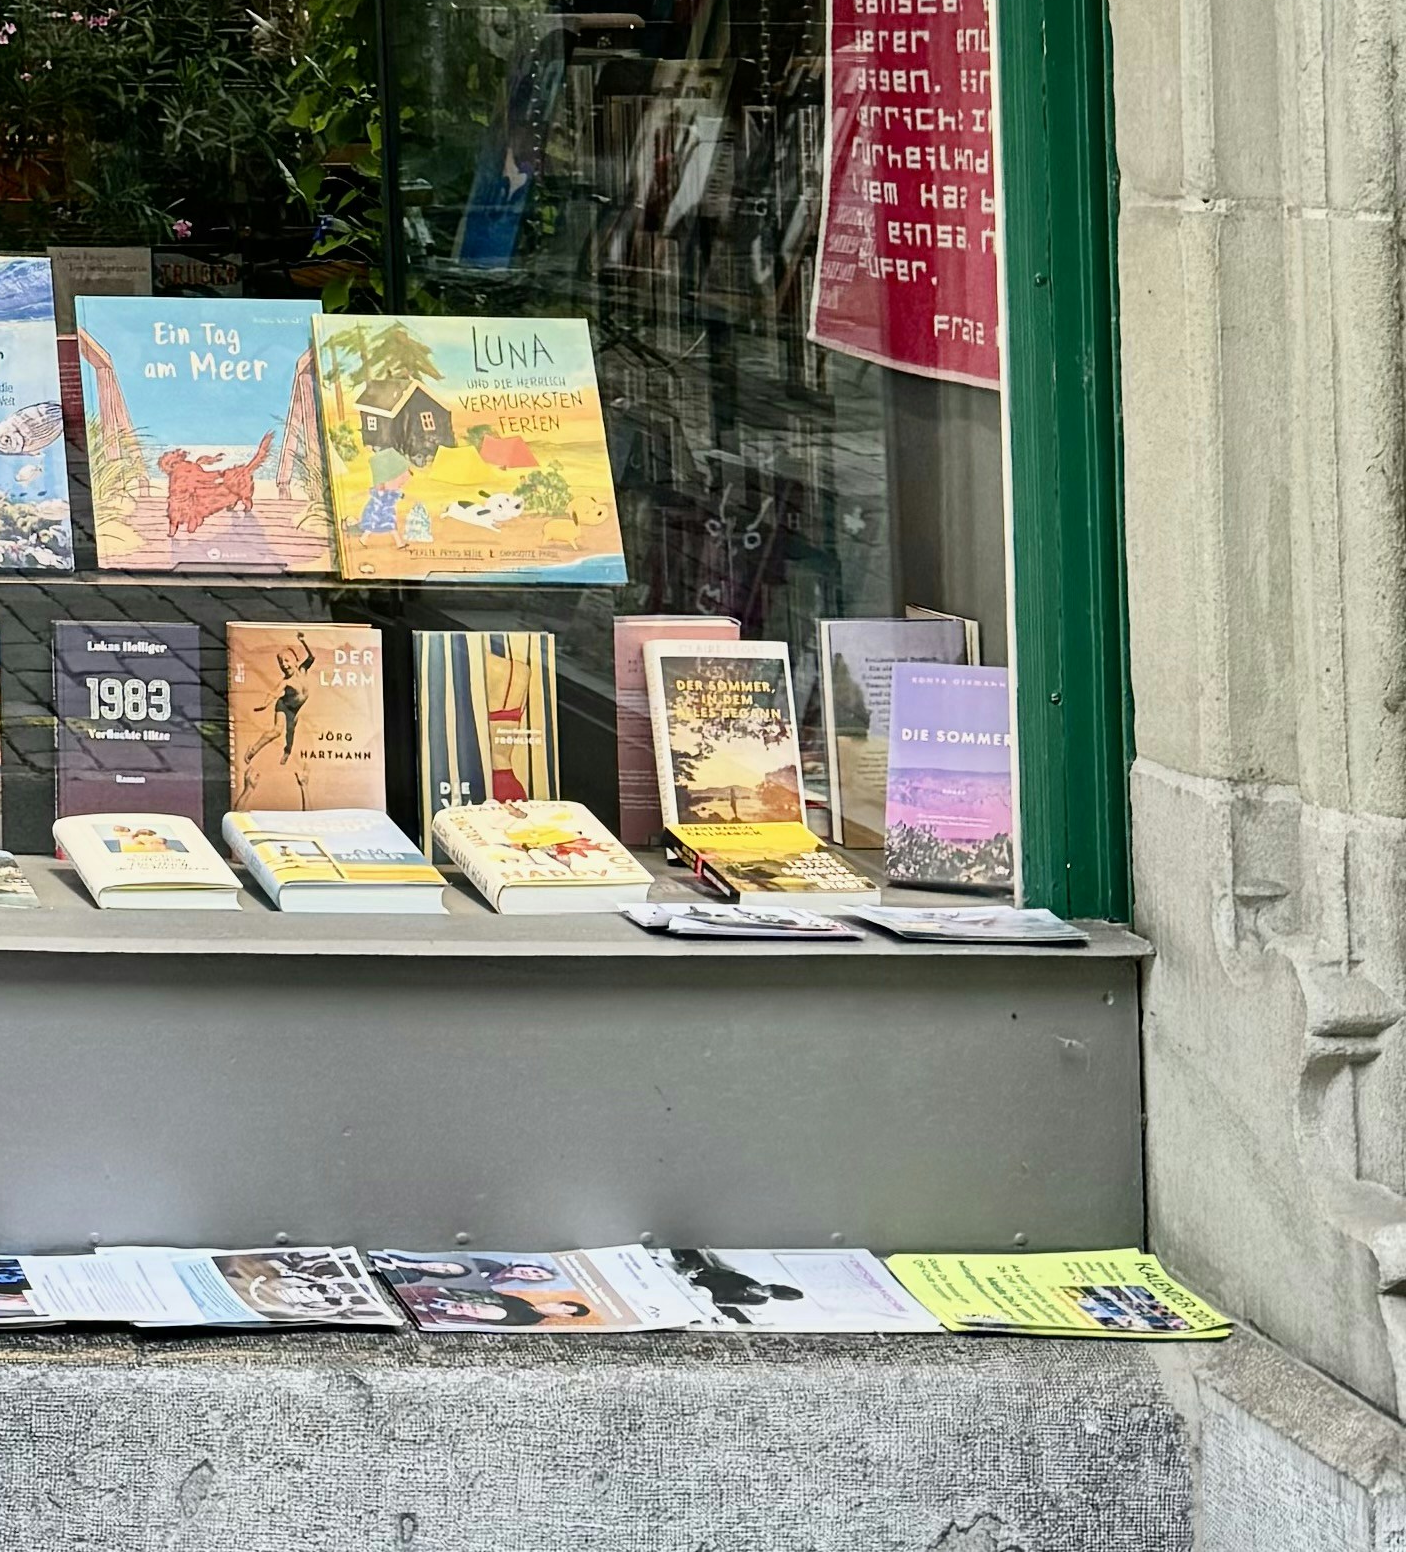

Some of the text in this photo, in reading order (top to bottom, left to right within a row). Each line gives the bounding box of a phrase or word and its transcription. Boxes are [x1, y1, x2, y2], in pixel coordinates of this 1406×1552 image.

[154, 322, 240, 355] Ein Tag
[472, 326, 554, 373] LUNA
[145, 351, 268, 381] am Meer
[467, 378, 489, 389] UND
[494, 377, 512, 390] DIE
[458, 391, 583, 413] VERMURKSTEN
[499, 415, 560, 434] FERIEN
[87, 641, 121, 654] Lukas
[334, 648, 375, 666] DER
[319, 670, 376, 688] LÄRM
[676, 680, 776, 694] DER SOMMER,
[86, 677, 172, 722] 1983
[701, 694, 753, 705] IN DEM
[721, 708, 781, 720] BEGANN
[318, 730, 354, 743] JÖRG
[901, 728, 1011, 747] DIE SOMMER
[300, 749, 372, 761] HARTMANN
[1134, 1263, 1197, 1308] KALENDER
